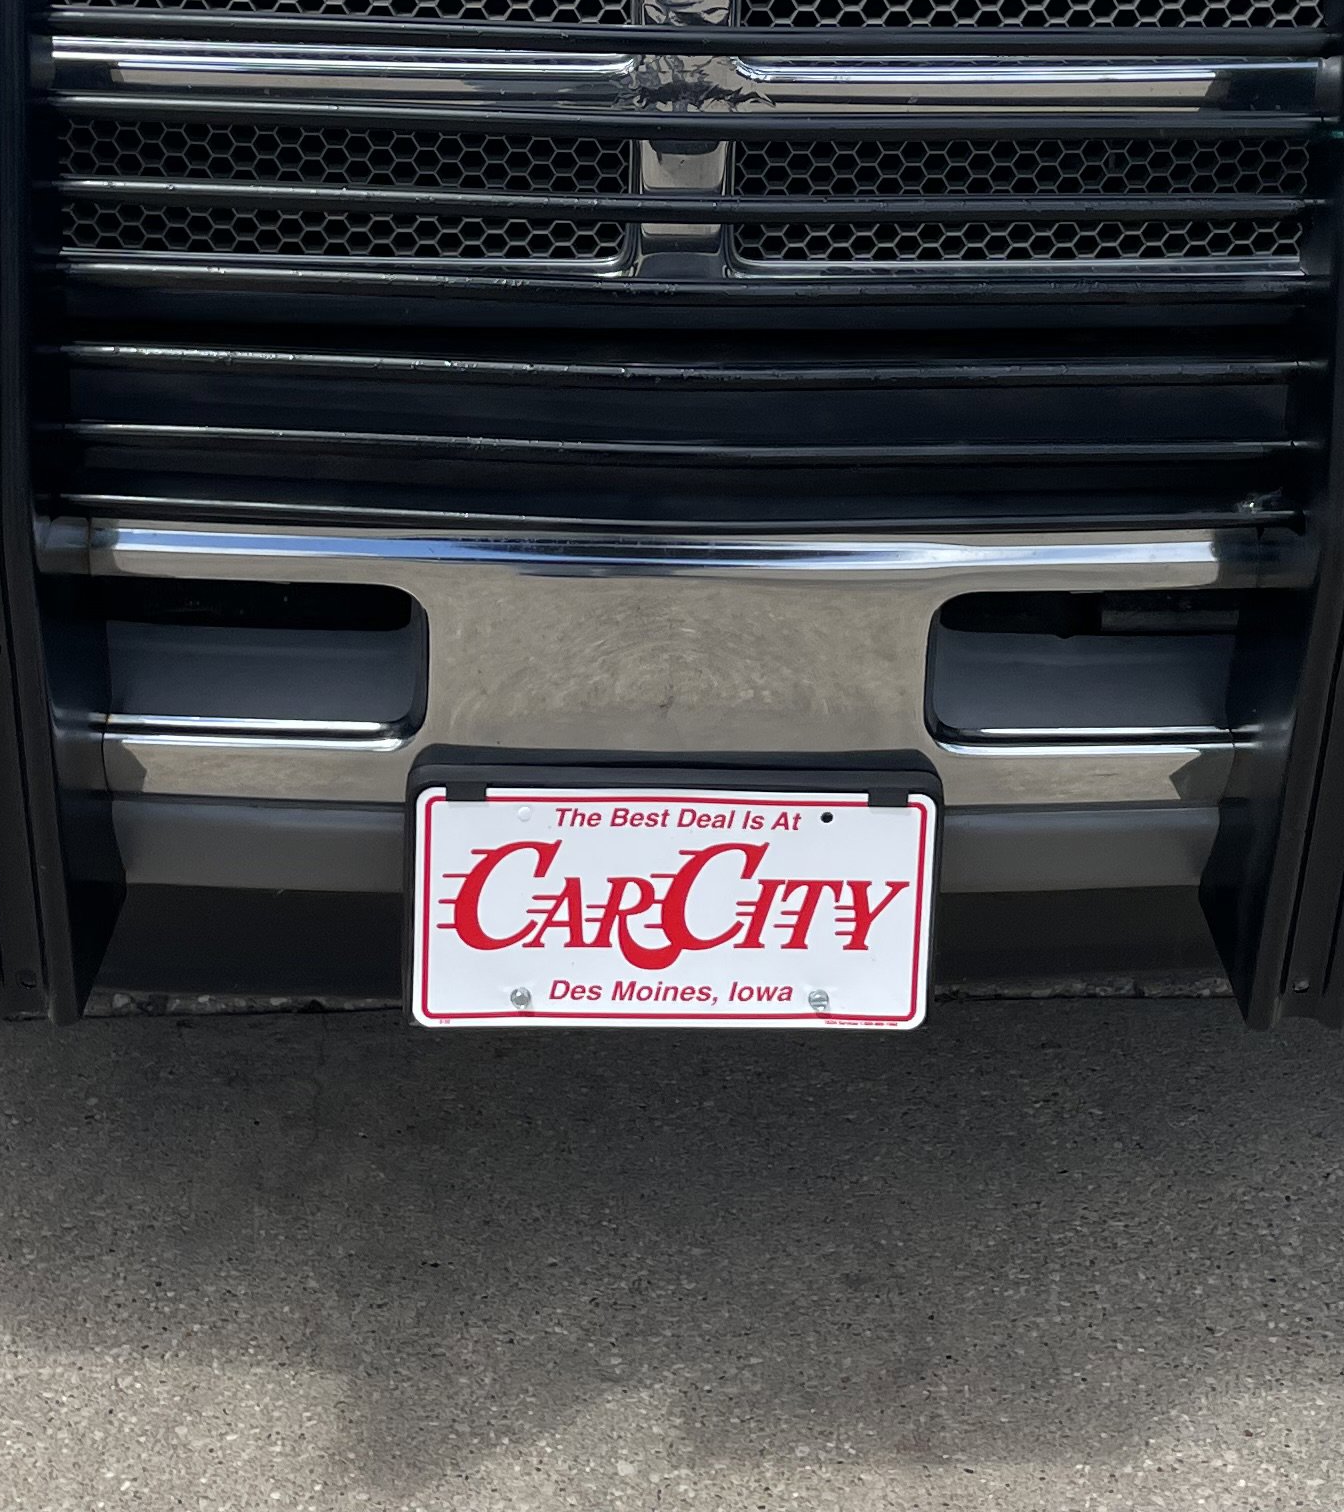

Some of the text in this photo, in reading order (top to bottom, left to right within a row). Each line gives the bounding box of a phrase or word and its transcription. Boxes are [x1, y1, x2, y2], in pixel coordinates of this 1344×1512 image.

[555, 807, 802, 831] The Best Deal Is At
[549, 979, 793, 1006] Des Moines, Iowa
